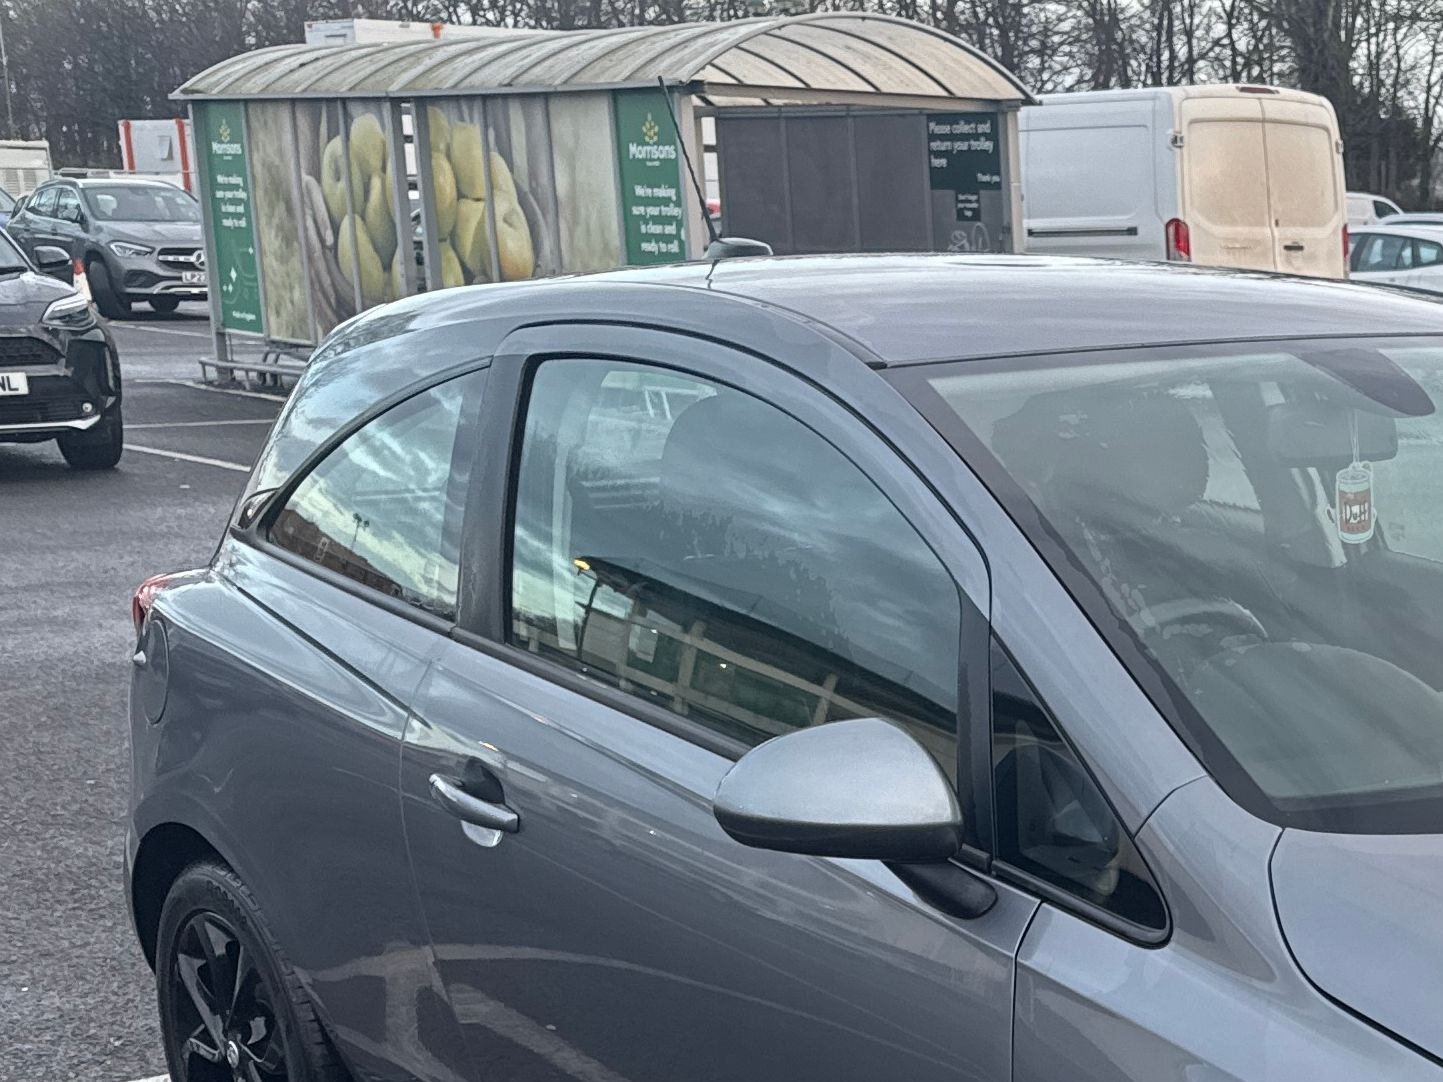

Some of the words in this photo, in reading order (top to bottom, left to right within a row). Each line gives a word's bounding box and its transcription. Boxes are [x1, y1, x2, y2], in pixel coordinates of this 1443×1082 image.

[628, 141, 677, 160] Morrisons
[653, 184, 676, 201] making
[631, 206, 645, 216] sure
[646, 206, 660, 219] your
[661, 203, 682, 220] trolley
[646, 220, 663, 234] clean
[663, 221, 677, 235] and
